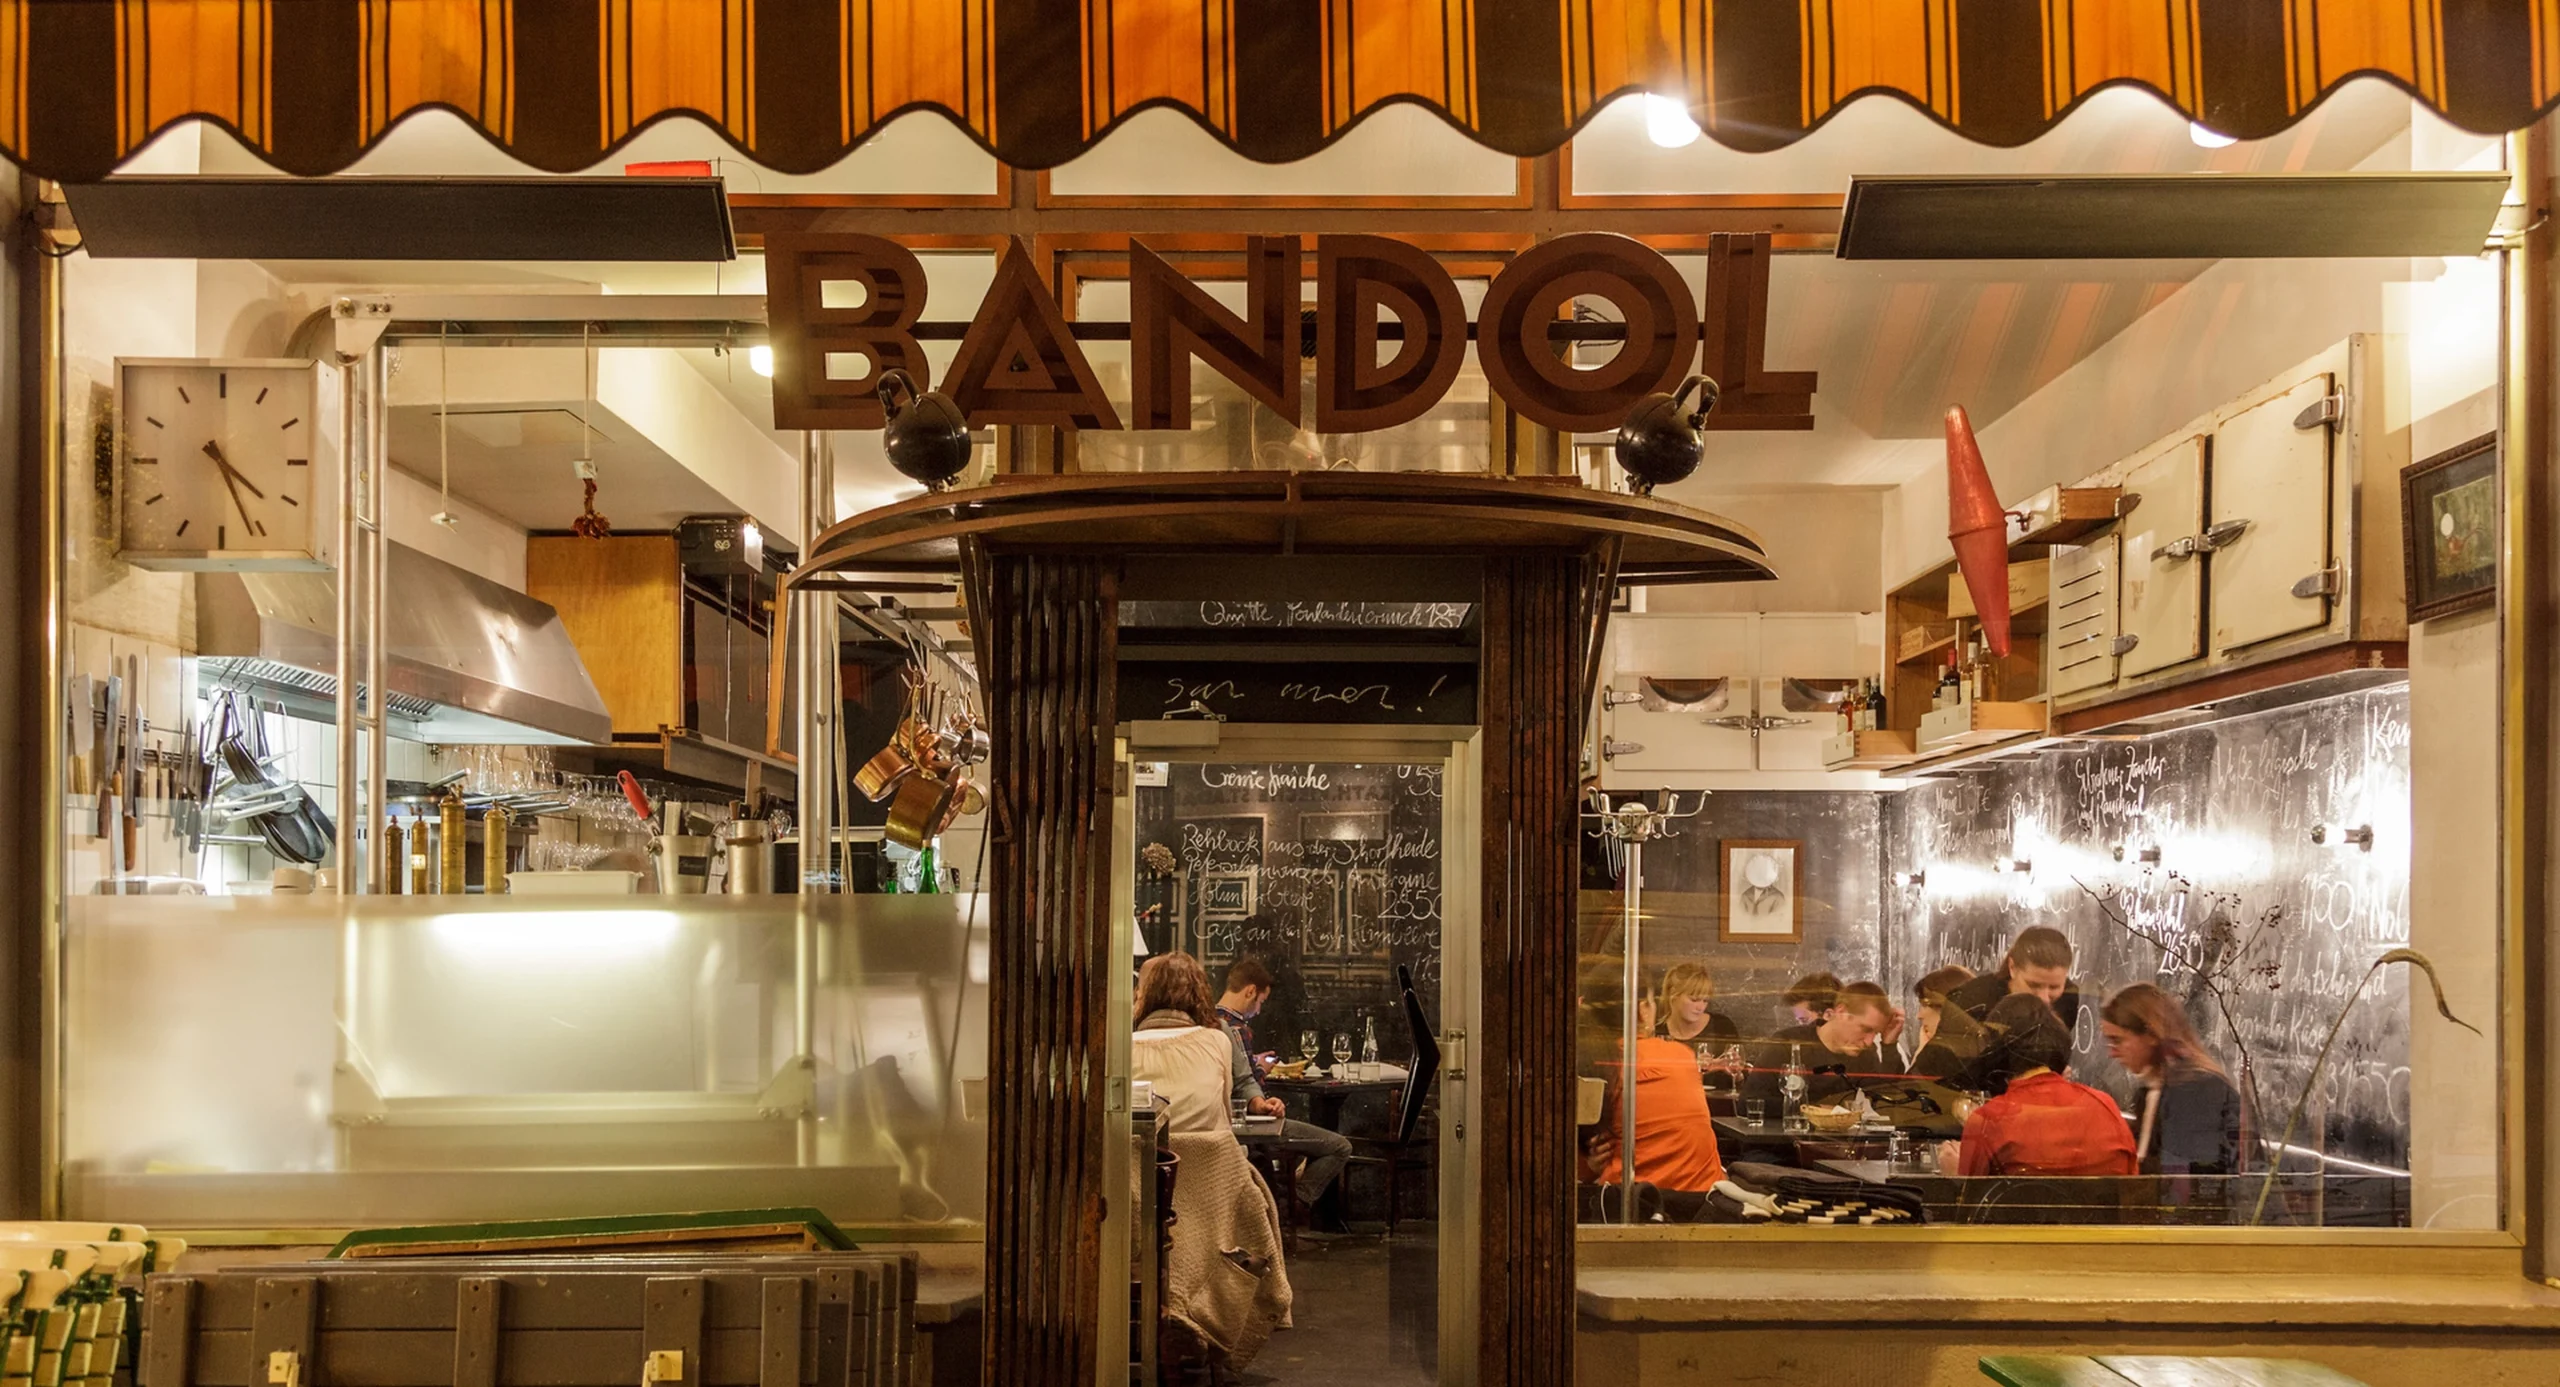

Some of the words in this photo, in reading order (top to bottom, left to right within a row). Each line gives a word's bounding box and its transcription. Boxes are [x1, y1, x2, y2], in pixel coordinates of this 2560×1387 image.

[766, 232, 1818, 433] BANDOL
[1181, 823, 1260, 857] Rehbock
[1267, 840, 1304, 857] aus
